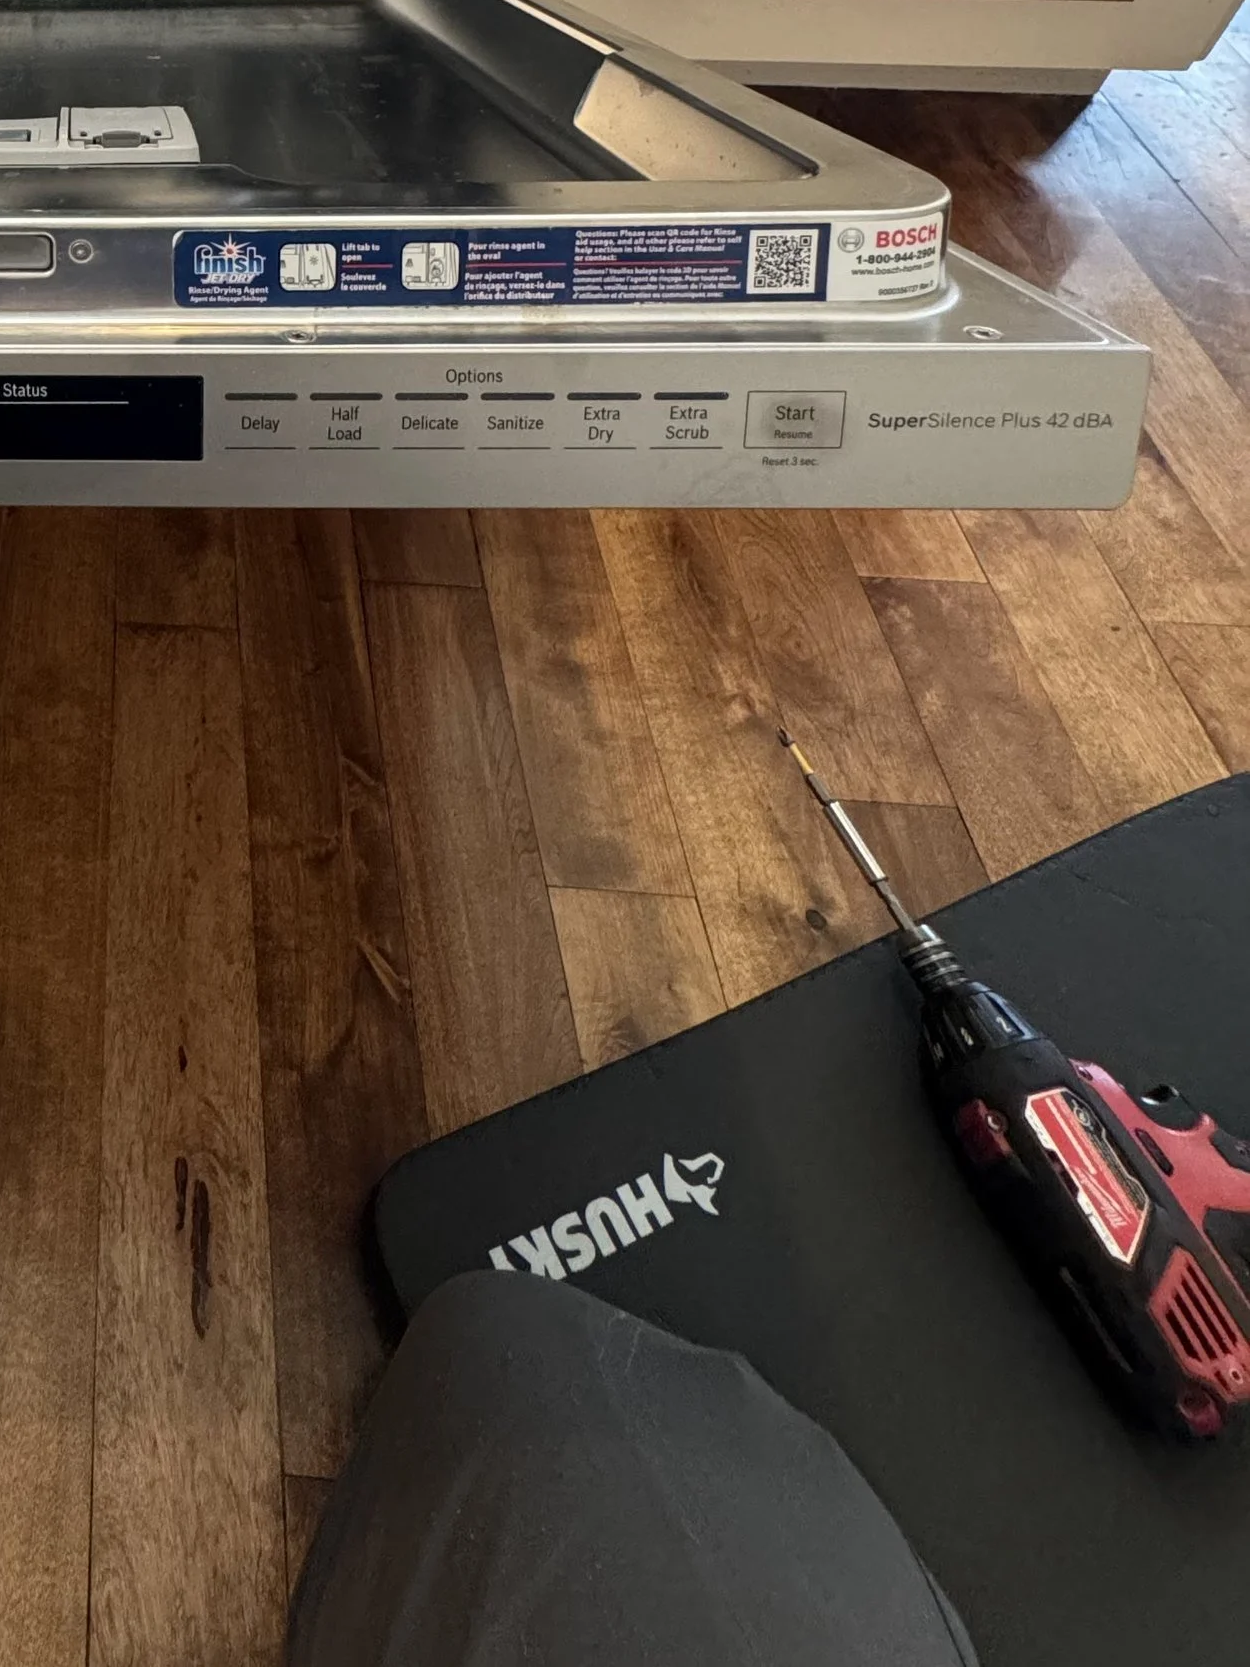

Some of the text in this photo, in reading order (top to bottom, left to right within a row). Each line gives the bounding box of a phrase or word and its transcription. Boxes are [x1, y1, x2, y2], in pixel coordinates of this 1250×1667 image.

[876, 223, 937, 248] BOSCH
[342, 243, 380, 251] Lift tab to
[468, 241, 546, 252] Pour rinse agent in
[342, 254, 362, 263] open
[468, 251, 501, 261] the oval
[856, 246, 936, 264] 1-800-944-2904
[188, 286, 269, 296] Rinse/Drying Agent
[445, 369, 503, 385] Options
[3, 382, 48, 398] Status
[331, 406, 360, 422] Half
[583, 406, 621, 421] Extra
[669, 406, 708, 421] Extra
[775, 405, 816, 421] Start
[241, 416, 280, 433] Delay
[401, 416, 459, 430] Delicate
[487, 416, 544, 430] Sanitize
[868, 412, 1113, 432] SuperSilence Plus 42 dBA
[327, 426, 362, 441] Load
[588, 426, 614, 443] Dry
[665, 425, 709, 440] Scrub
[774, 429, 813, 439] Resume
[762, 456, 789, 466] Reset
[790, 456, 798, 466] 3
